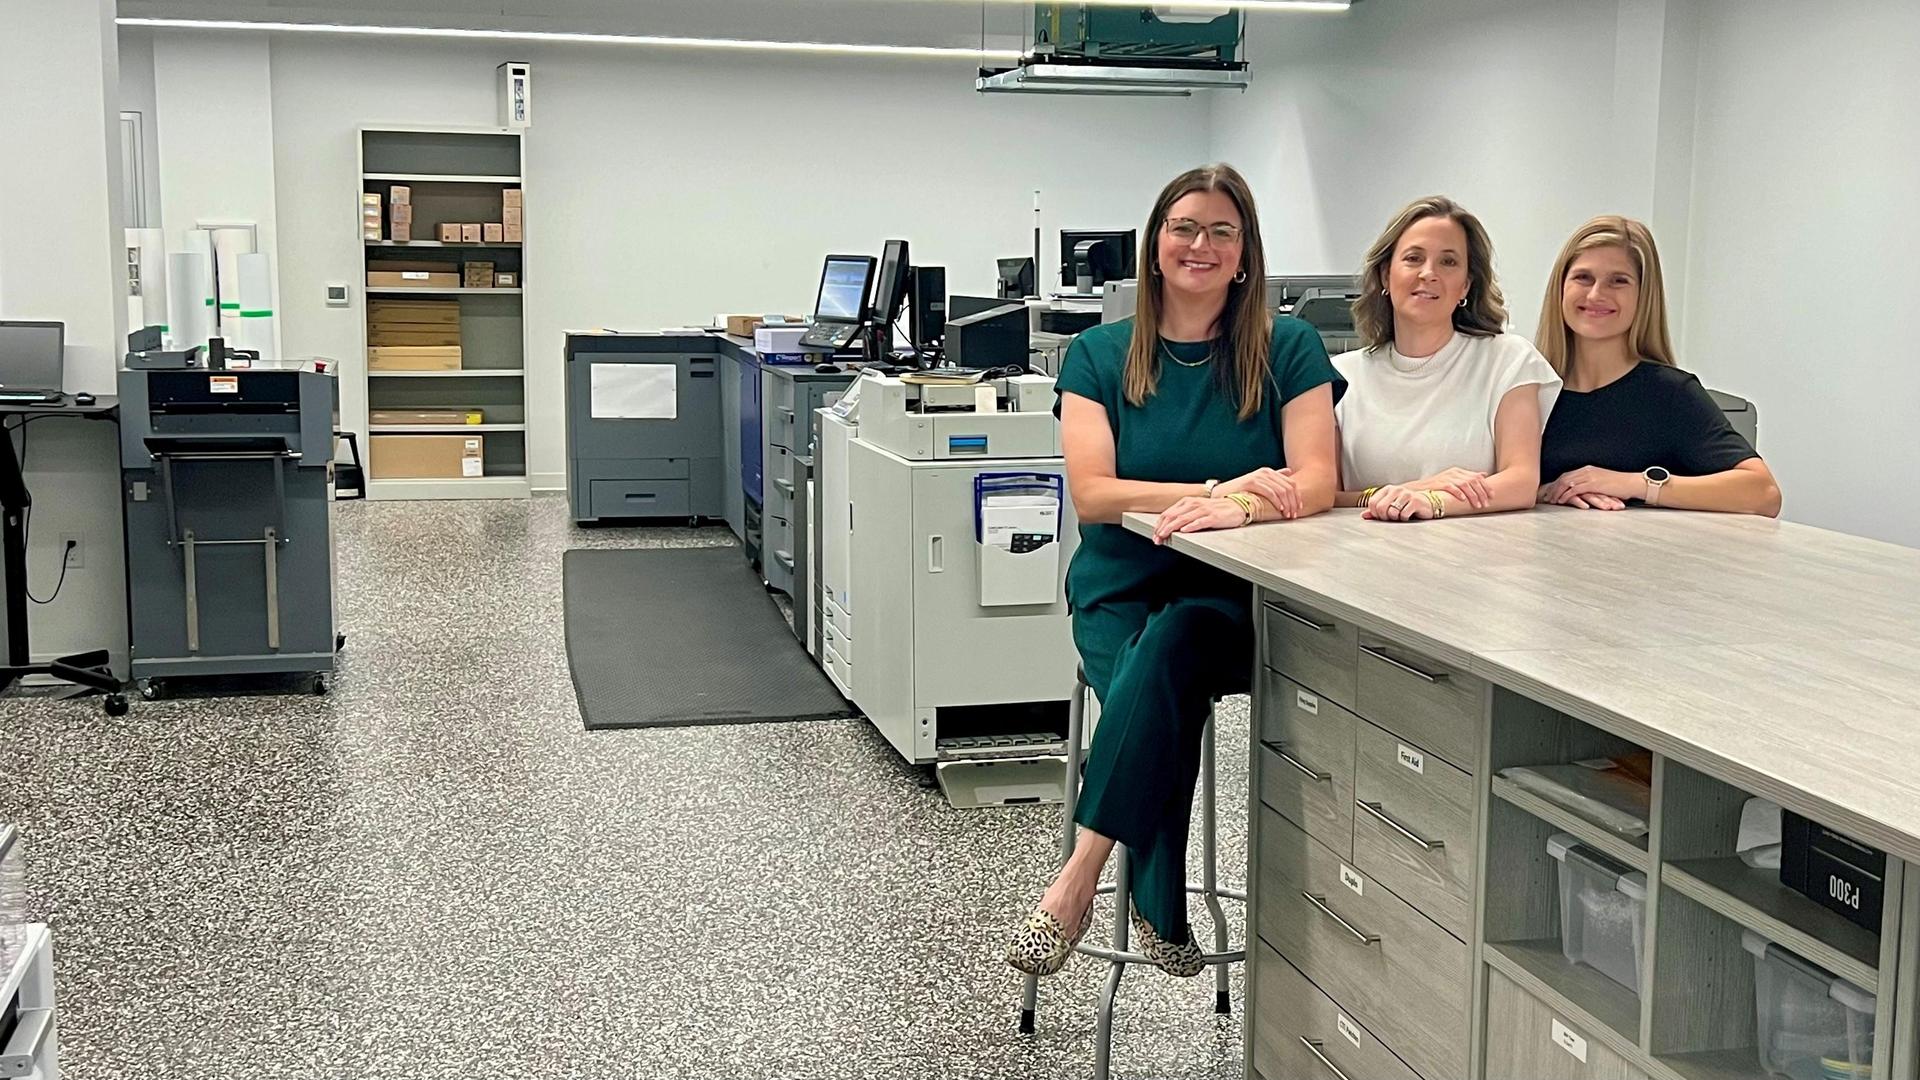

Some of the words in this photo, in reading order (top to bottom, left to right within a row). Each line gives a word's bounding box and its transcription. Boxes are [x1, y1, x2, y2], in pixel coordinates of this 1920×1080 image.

[1400, 751, 1411, 764] First
[1411, 757, 1420, 768] Aid
[1829, 874, 1860, 910] P300
